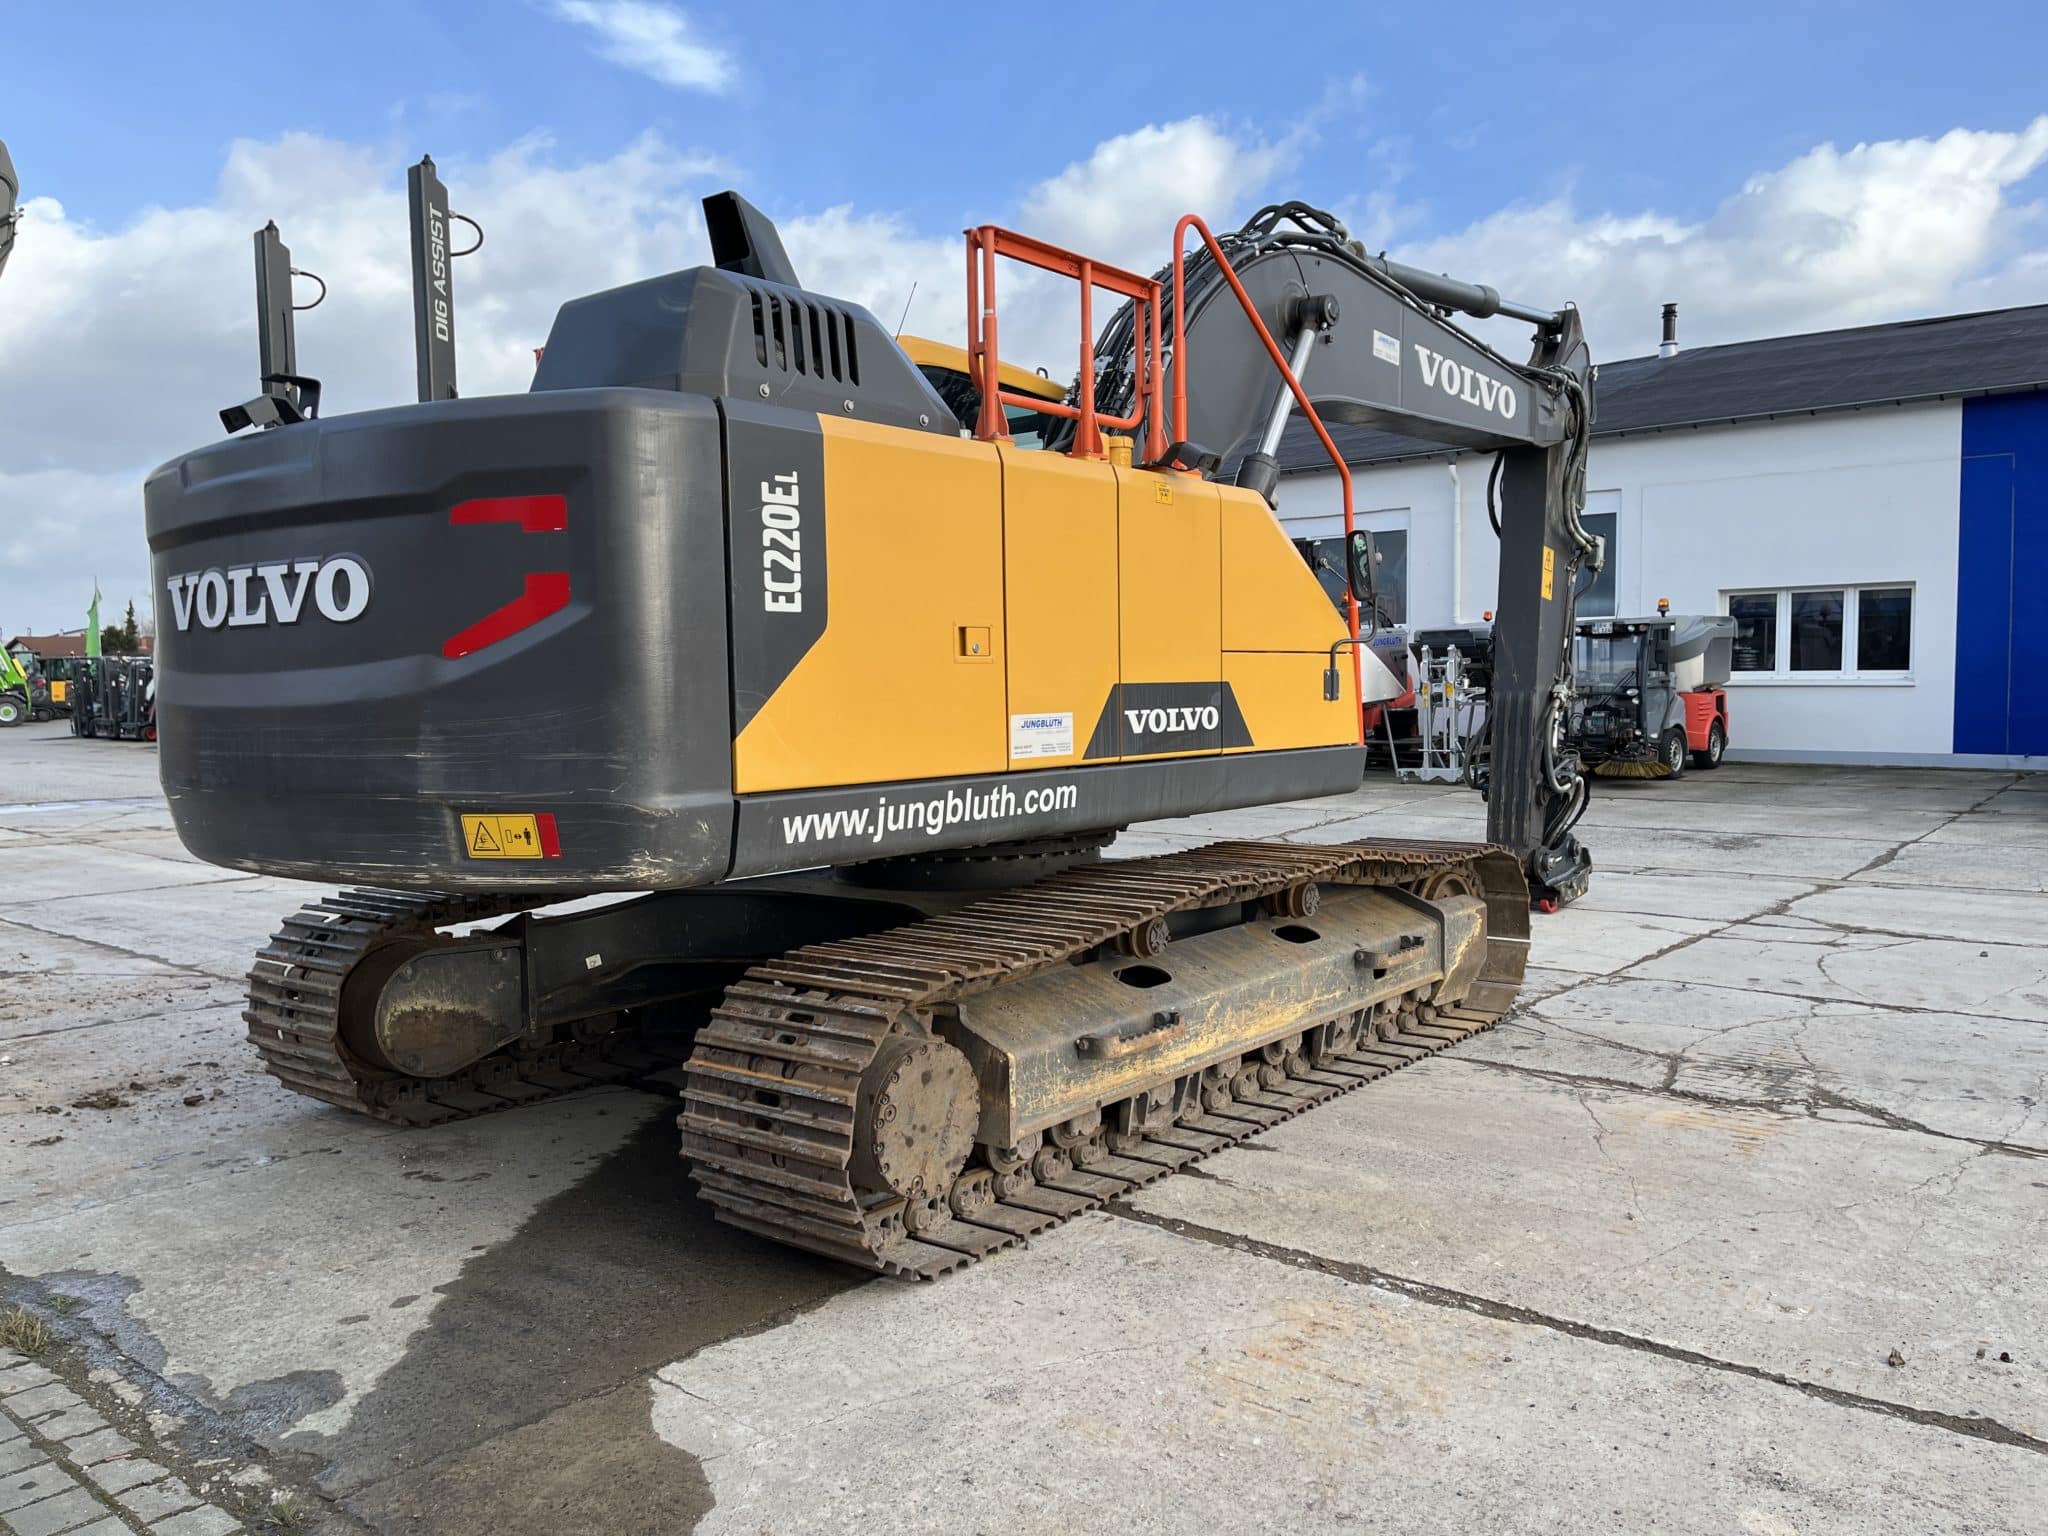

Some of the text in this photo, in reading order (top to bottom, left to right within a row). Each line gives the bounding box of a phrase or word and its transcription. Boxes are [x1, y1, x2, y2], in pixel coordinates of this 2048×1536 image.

[429, 202, 449, 342] DIG ASSIST
[1414, 343, 1517, 419] VOLVO
[167, 557, 370, 632] VOLVO
[1021, 717, 1063, 729] JUNGBLUTH
[1123, 706, 1219, 734] VOLVO
[782, 784, 1078, 844] www.jungbluth.com
